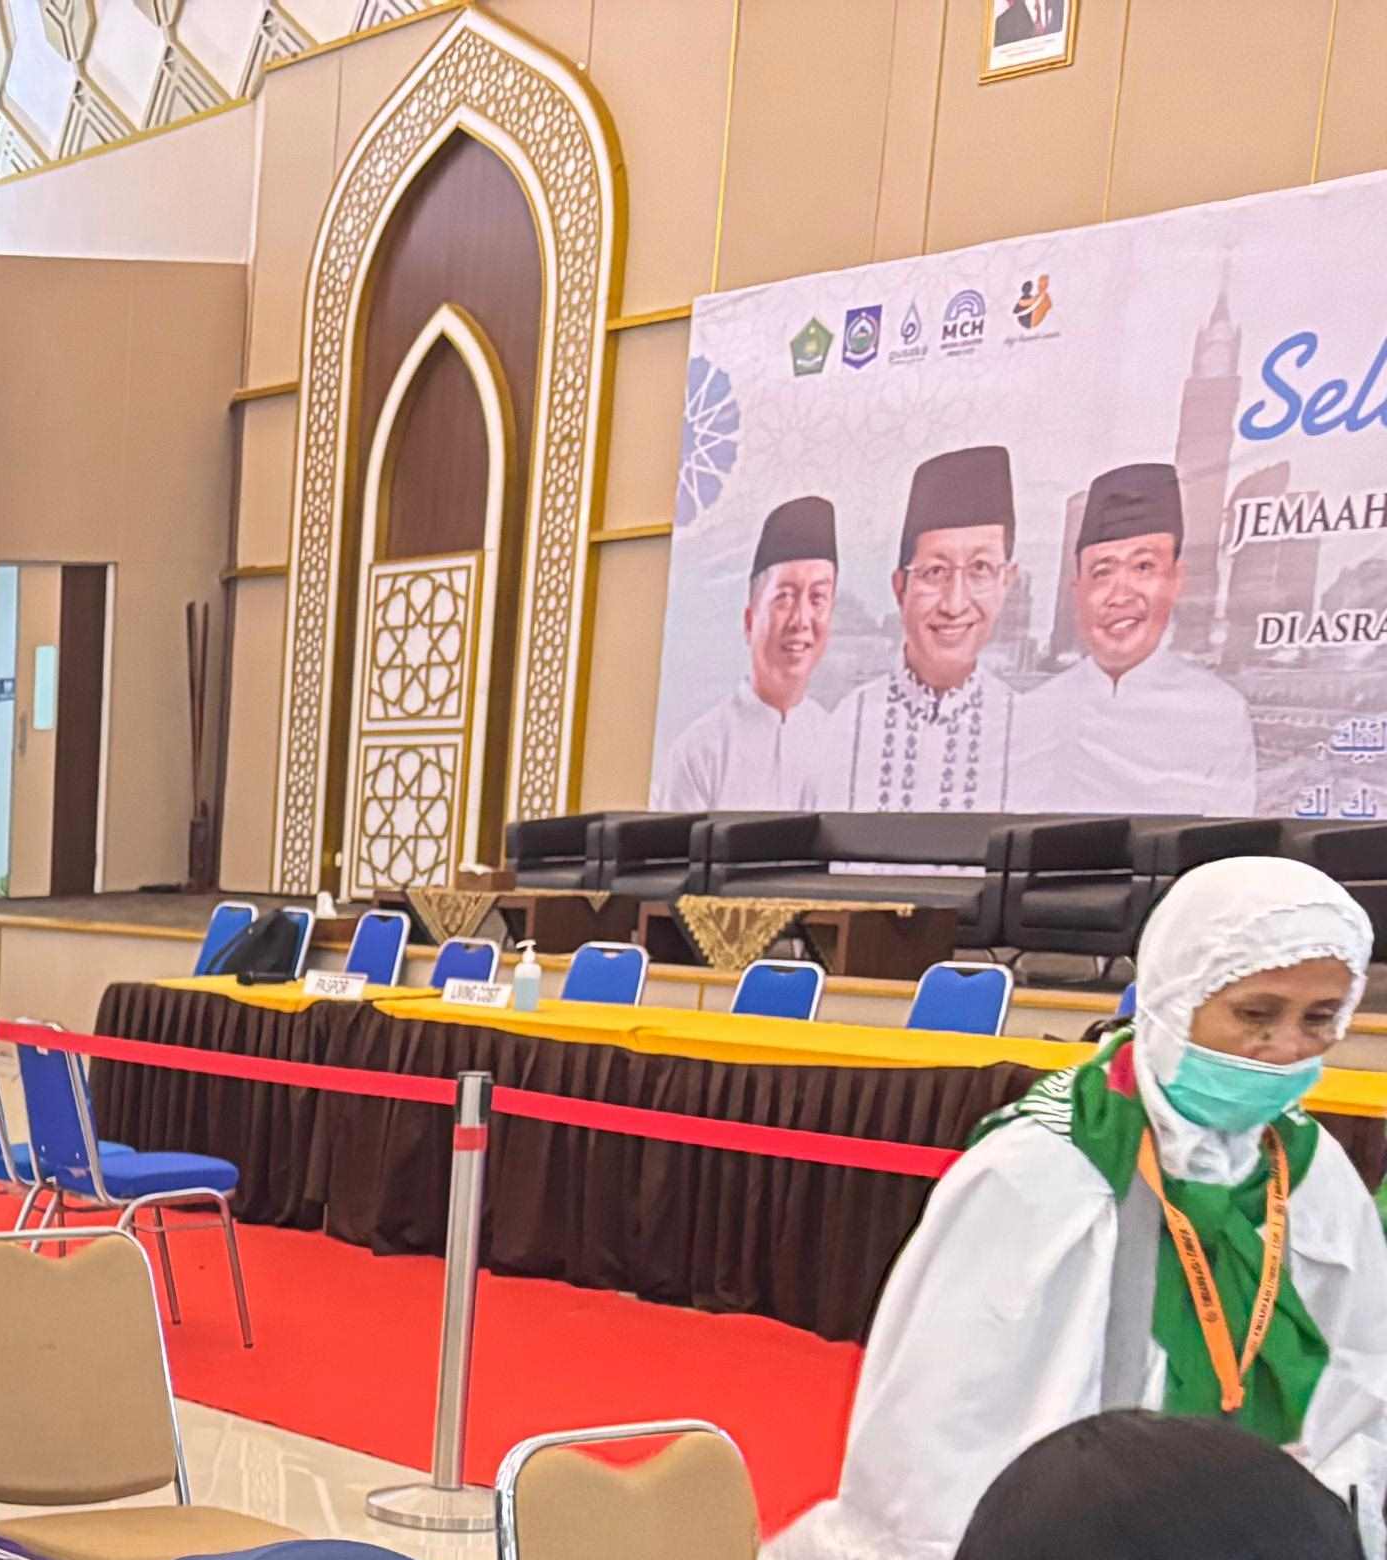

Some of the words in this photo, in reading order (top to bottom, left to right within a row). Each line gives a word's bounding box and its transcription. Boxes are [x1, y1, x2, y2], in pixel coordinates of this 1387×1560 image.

[941, 318, 985, 341] MCH
[1238, 331, 1387, 441] Sel
[1260, 614, 1299, 645] DI
